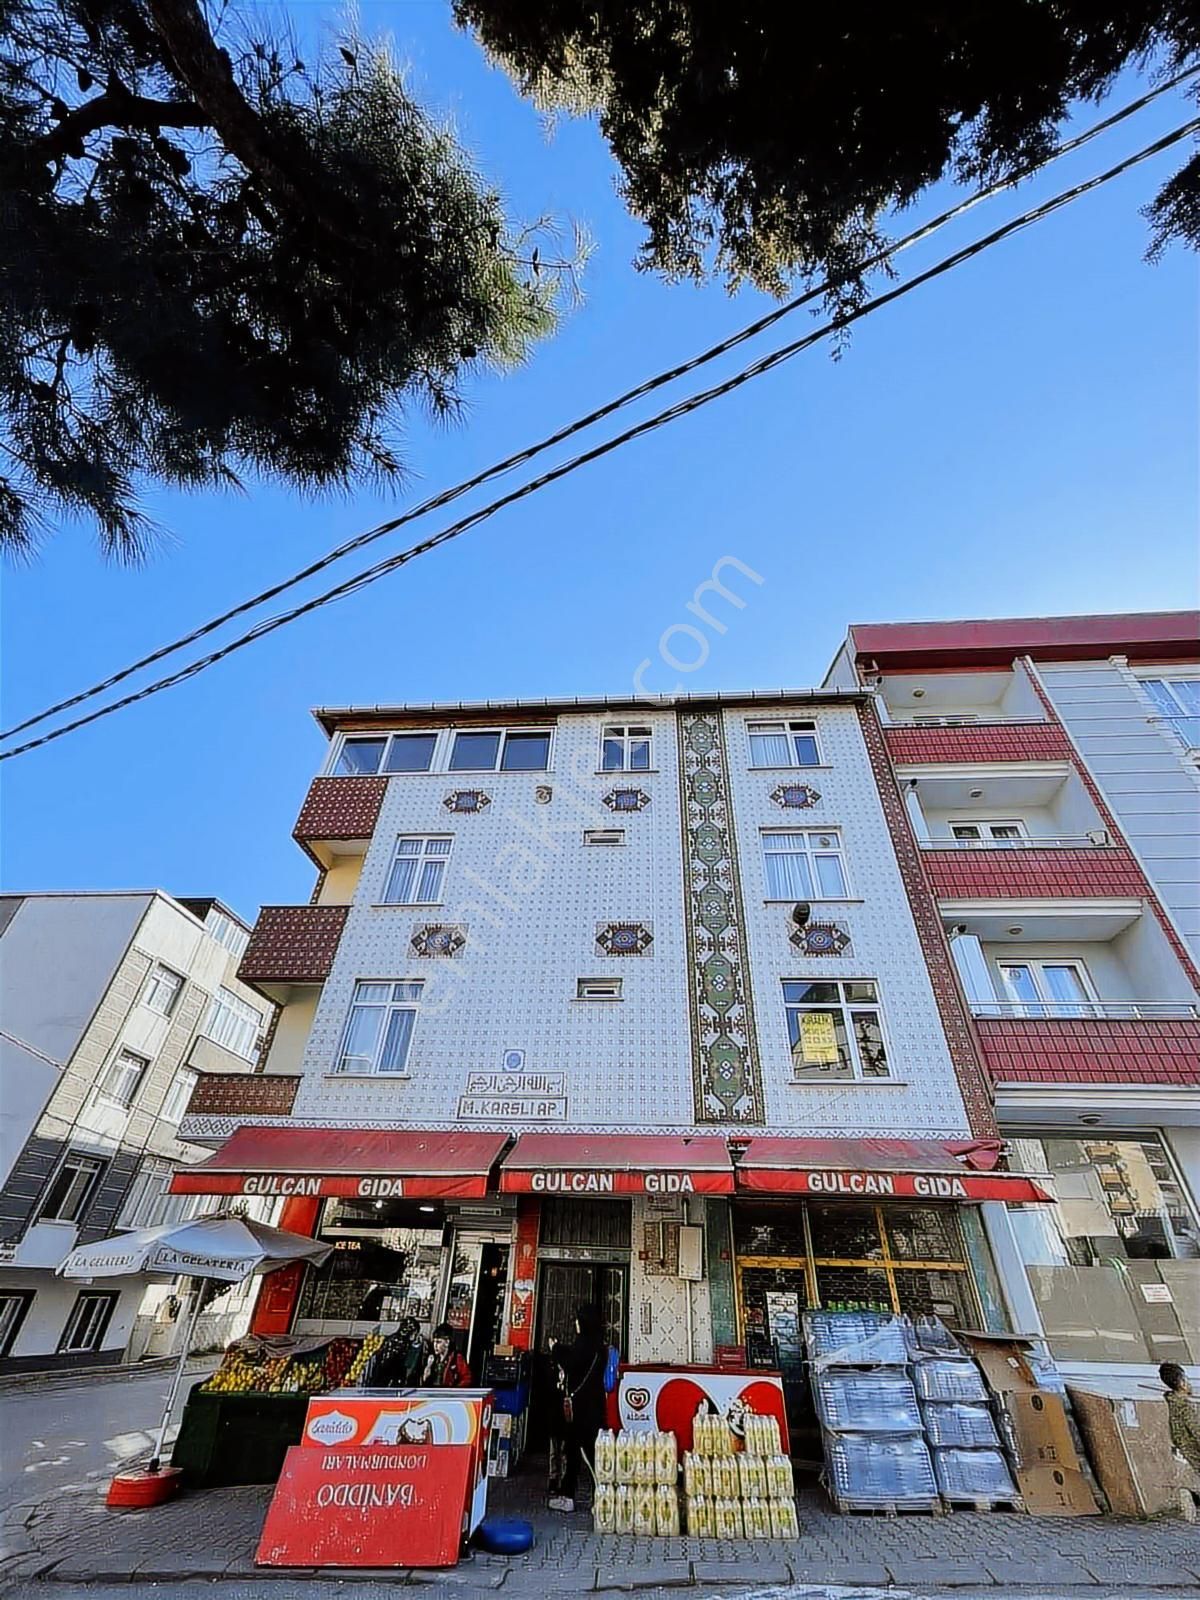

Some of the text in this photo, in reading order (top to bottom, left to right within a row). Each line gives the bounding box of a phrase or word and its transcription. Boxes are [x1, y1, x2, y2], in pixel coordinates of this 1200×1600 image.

[358, 1178, 403, 1197] GIDA
[645, 1173, 694, 1193] GIDA
[913, 1176, 967, 1197] GIDA
[347, 1240, 362, 1251] TEA
[162, 1251, 246, 1273] LA GELATERIA
